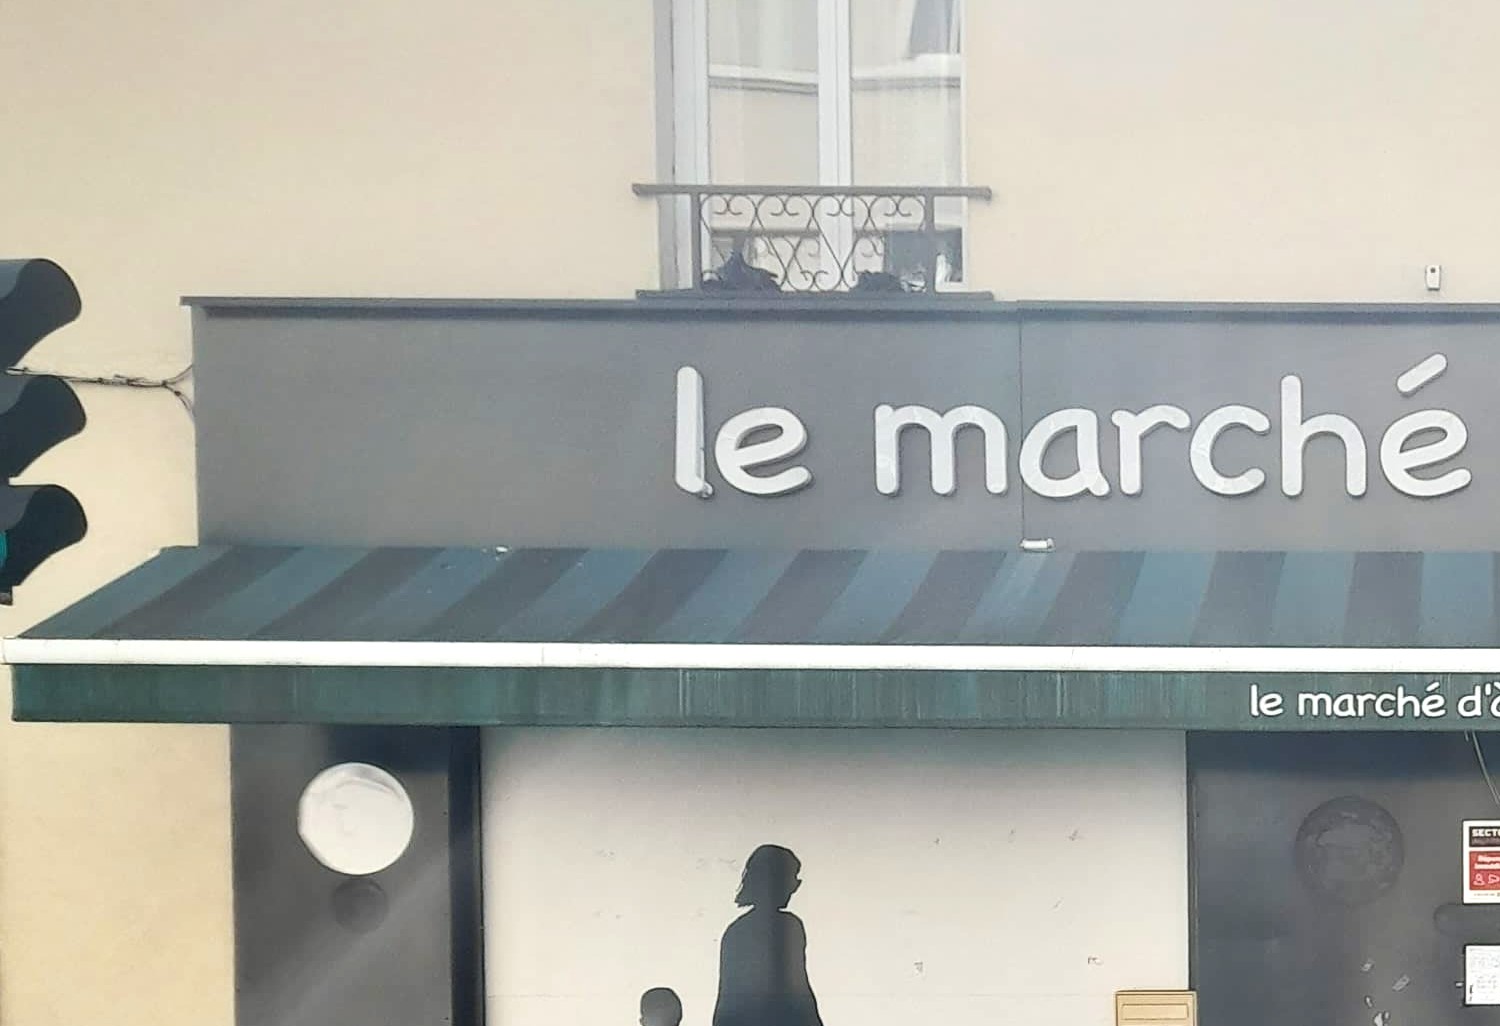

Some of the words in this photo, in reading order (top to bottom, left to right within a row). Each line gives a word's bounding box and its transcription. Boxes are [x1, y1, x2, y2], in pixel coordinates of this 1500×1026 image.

[674, 366, 813, 498] le
[874, 352, 1474, 499] marché
[1249, 684, 1284, 718] le
[1297, 681, 1447, 718] marché
